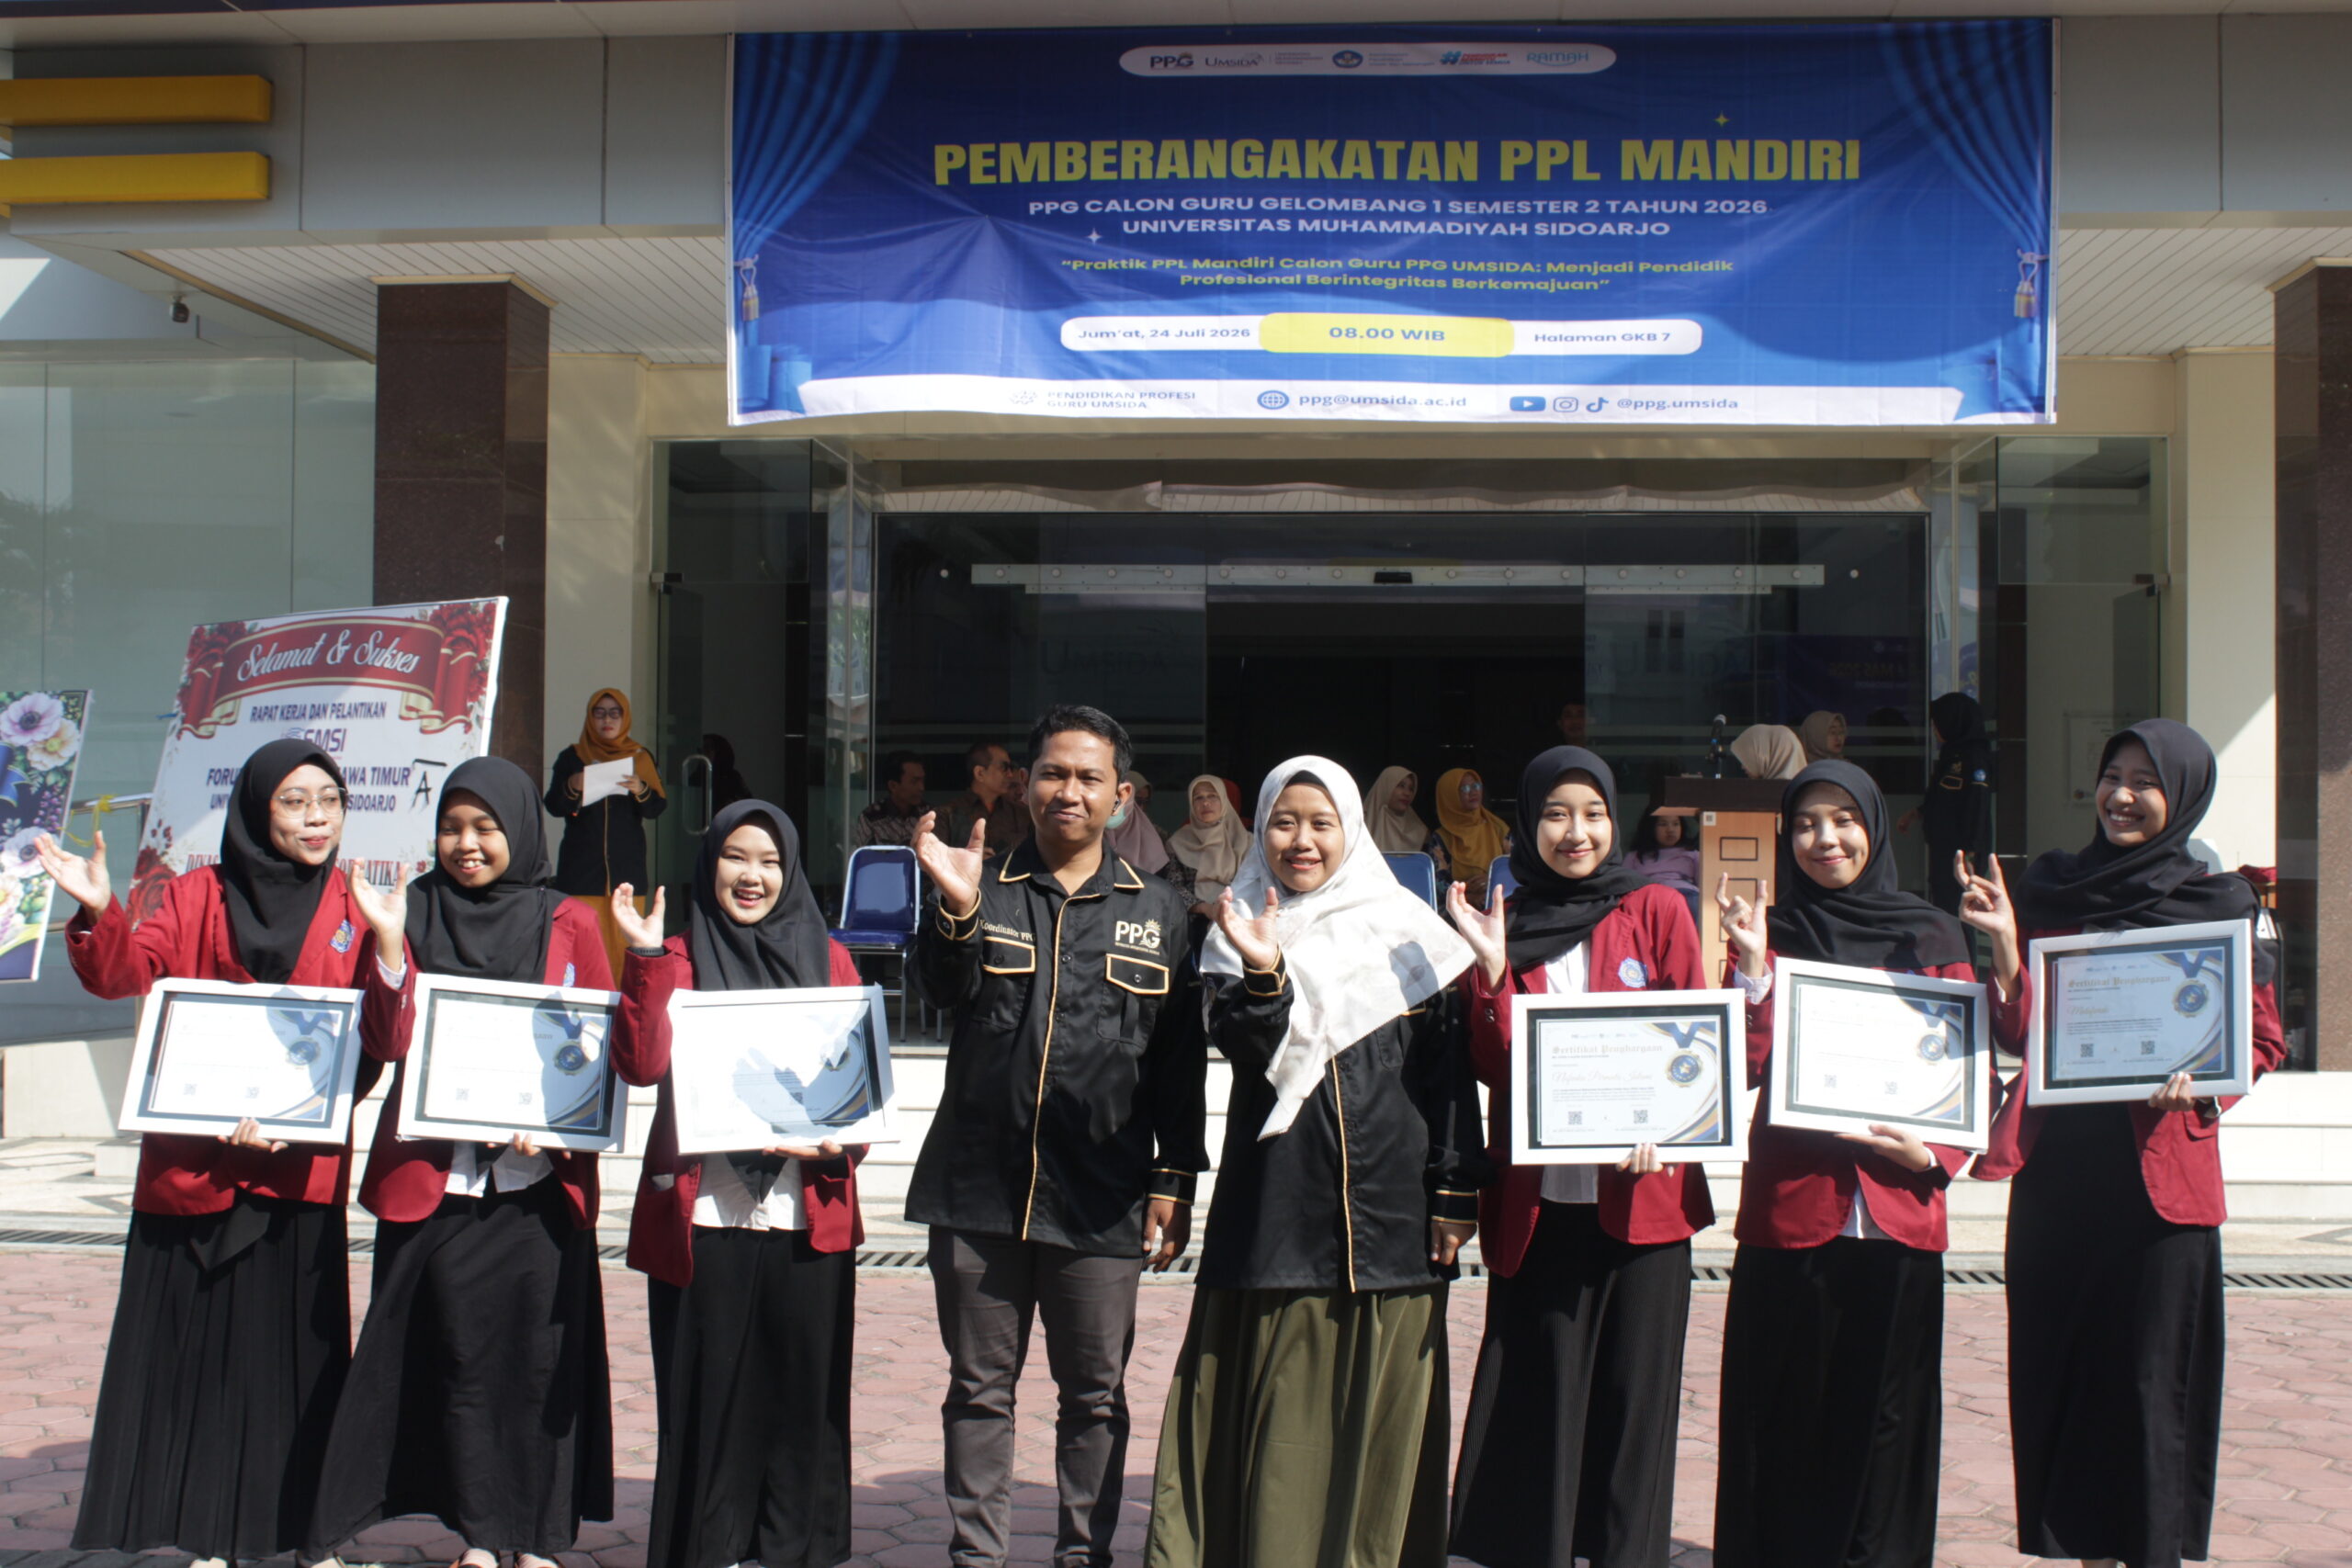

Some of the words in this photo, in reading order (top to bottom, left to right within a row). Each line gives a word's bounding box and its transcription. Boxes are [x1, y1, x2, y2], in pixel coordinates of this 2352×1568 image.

[1149, 53, 1194, 69] PPG
[933, 139, 1478, 186] PEMBERANGAKATAN
[1499, 140, 1601, 181] PPL
[1621, 139, 1860, 181] MANDIRI
[1028, 200, 1080, 216] PPG
[1084, 197, 1175, 214] CALON
[1180, 197, 1254, 211] GURU
[1259, 197, 1427, 213] GELOMBANG
[1431, 199, 1442, 213] 1
[1448, 199, 1578, 215] SEMESTER
[1584, 199, 1600, 214] 2
[1605, 199, 1699, 214] TAHUN
[1703, 199, 1768, 215] 2026
[1123, 219, 1292, 234] UNIVERSITAS
[1298, 219, 1528, 236] MUHAMMADIYAH
[1533, 220, 1670, 236] SIDOARJO
[1151, 258, 1187, 270] PPL
[1192, 257, 1274, 269] Mandiri
[1278, 257, 1343, 269] Calon
[1348, 257, 1401, 270] Guru
[1405, 259, 1448, 271] PPG
[1452, 260, 1542, 273] UMSIDA:
[1546, 260, 1634, 276] Menjadi
[1638, 259, 1734, 273] Pendidik
[1180, 274, 1301, 286] Profesional
[1306, 273, 1448, 289] Berintegritas
[1149, 329, 1170, 338] 24
[1174, 328, 1206, 338] Juli
[1209, 328, 1251, 338] 2026
[1329, 327, 1395, 339] 08.00
[1401, 330, 1446, 341] WIB
[1534, 333, 1617, 343] Halaman
[1621, 333, 1657, 342] GKB
[1660, 333, 1671, 342] 7
[1047, 390, 1135, 400] PENDIDIKAN
[1138, 391, 1196, 400] PROFESI
[1298, 394, 1467, 407] ppg@umsida.ac.id
[1047, 400, 1088, 409] GURU
[1091, 400, 1148, 409] UMSIDA
[1617, 398, 1738, 411] @ppg.umsida
[237, 632, 326, 682] Selamat
[328, 629, 350, 664] &
[355, 630, 421, 673] Sukses
[250, 705, 277, 722] RAPAT
[279, 704, 307, 721] KERJA
[309, 703, 329, 720] DAN
[329, 701, 388, 720] PELANTIKAN
[370, 766, 412, 787] TIMUR
[347, 794, 397, 813] SIDOARJO
[1114, 919, 1161, 949] PPG
